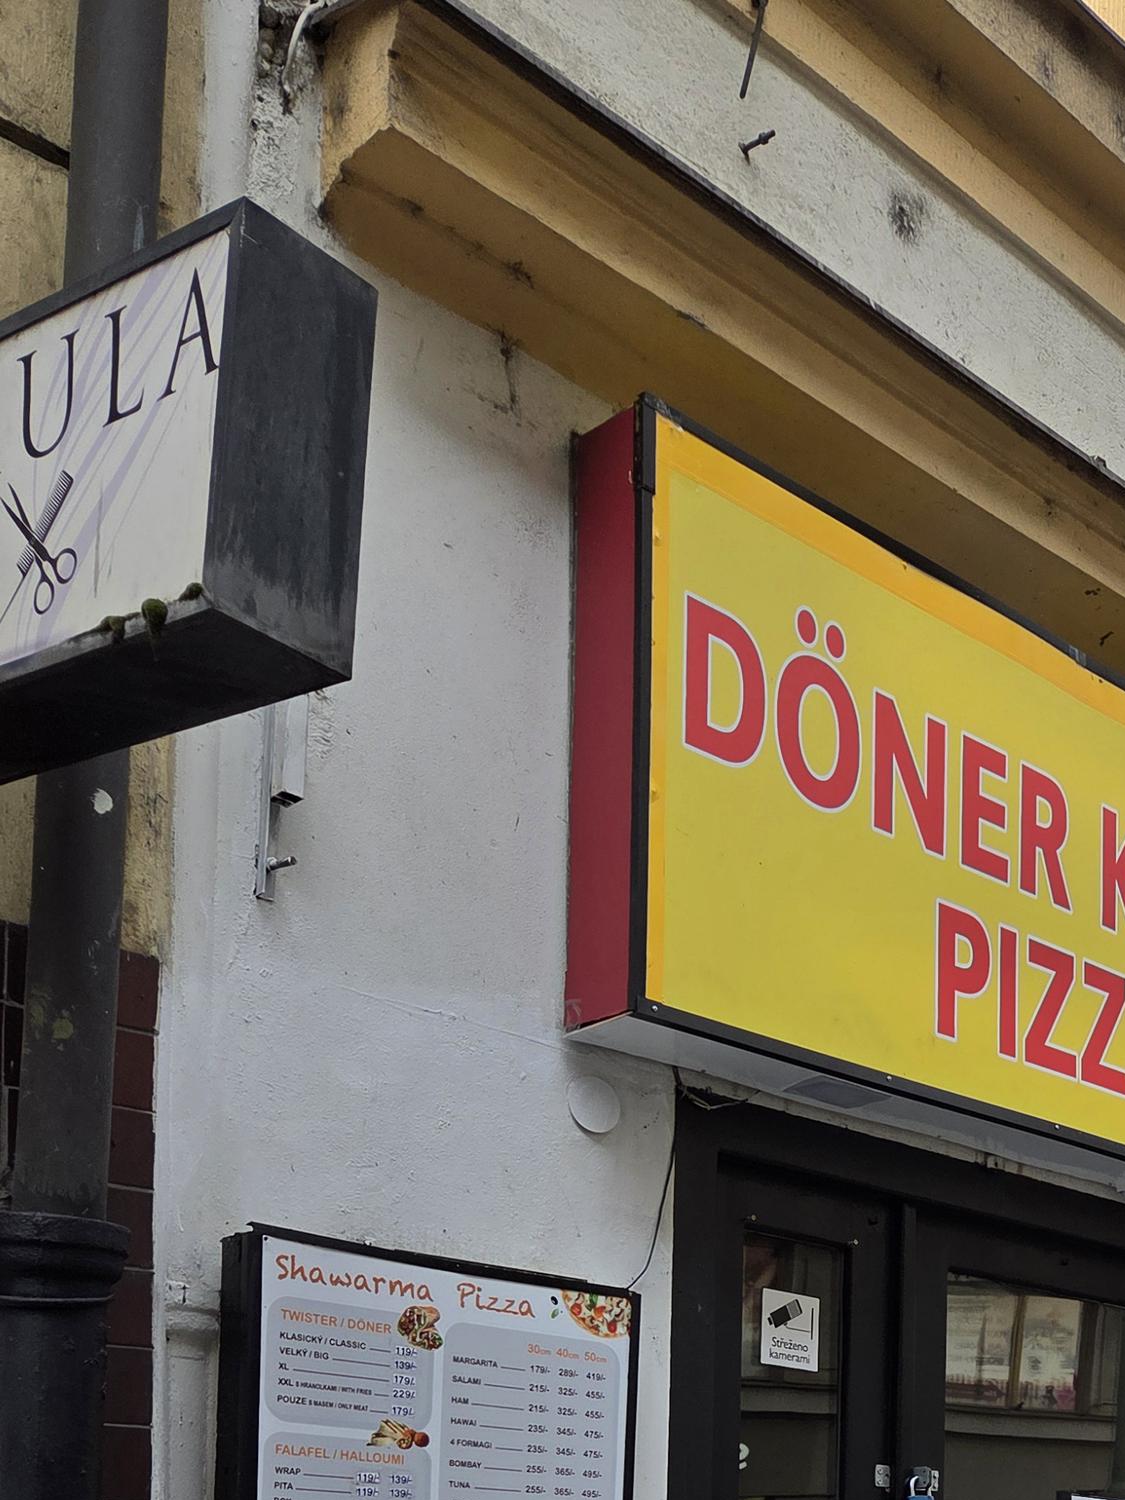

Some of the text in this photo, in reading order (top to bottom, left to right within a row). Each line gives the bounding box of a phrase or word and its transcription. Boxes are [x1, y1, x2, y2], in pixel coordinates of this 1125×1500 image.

[16, 266, 219, 458] ULA
[682, 591, 1073, 913] DÖNER
[275, 1254, 535, 1318] Shawarma Pizza
[281, 1309, 337, 1327] TWISTER
[279, 1331, 366, 1350] KLASICKÝ CLASSIC
[772, 1337, 808, 1352] Střeženo
[279, 1347, 329, 1360] VELKÝ BIG
[769, 1348, 810, 1363] kamerami
[278, 1362, 289, 1370] XL
[453, 1356, 498, 1368] MARGARITA
[278, 1378, 294, 1387] XXL
[452, 1376, 481, 1385] SALAMI
[277, 1394, 306, 1405] POUZE
[451, 1418, 477, 1426] HAWAI
[457, 1440, 492, 1448] FORMAGI
[275, 1444, 404, 1465] FALAFEL HALLOUMI
[449, 1460, 482, 1469] BOMBAY
[275, 1467, 301, 1476] WRAP
[274, 1482, 293, 1490] PITA
[449, 1481, 470, 1489] TUNA
